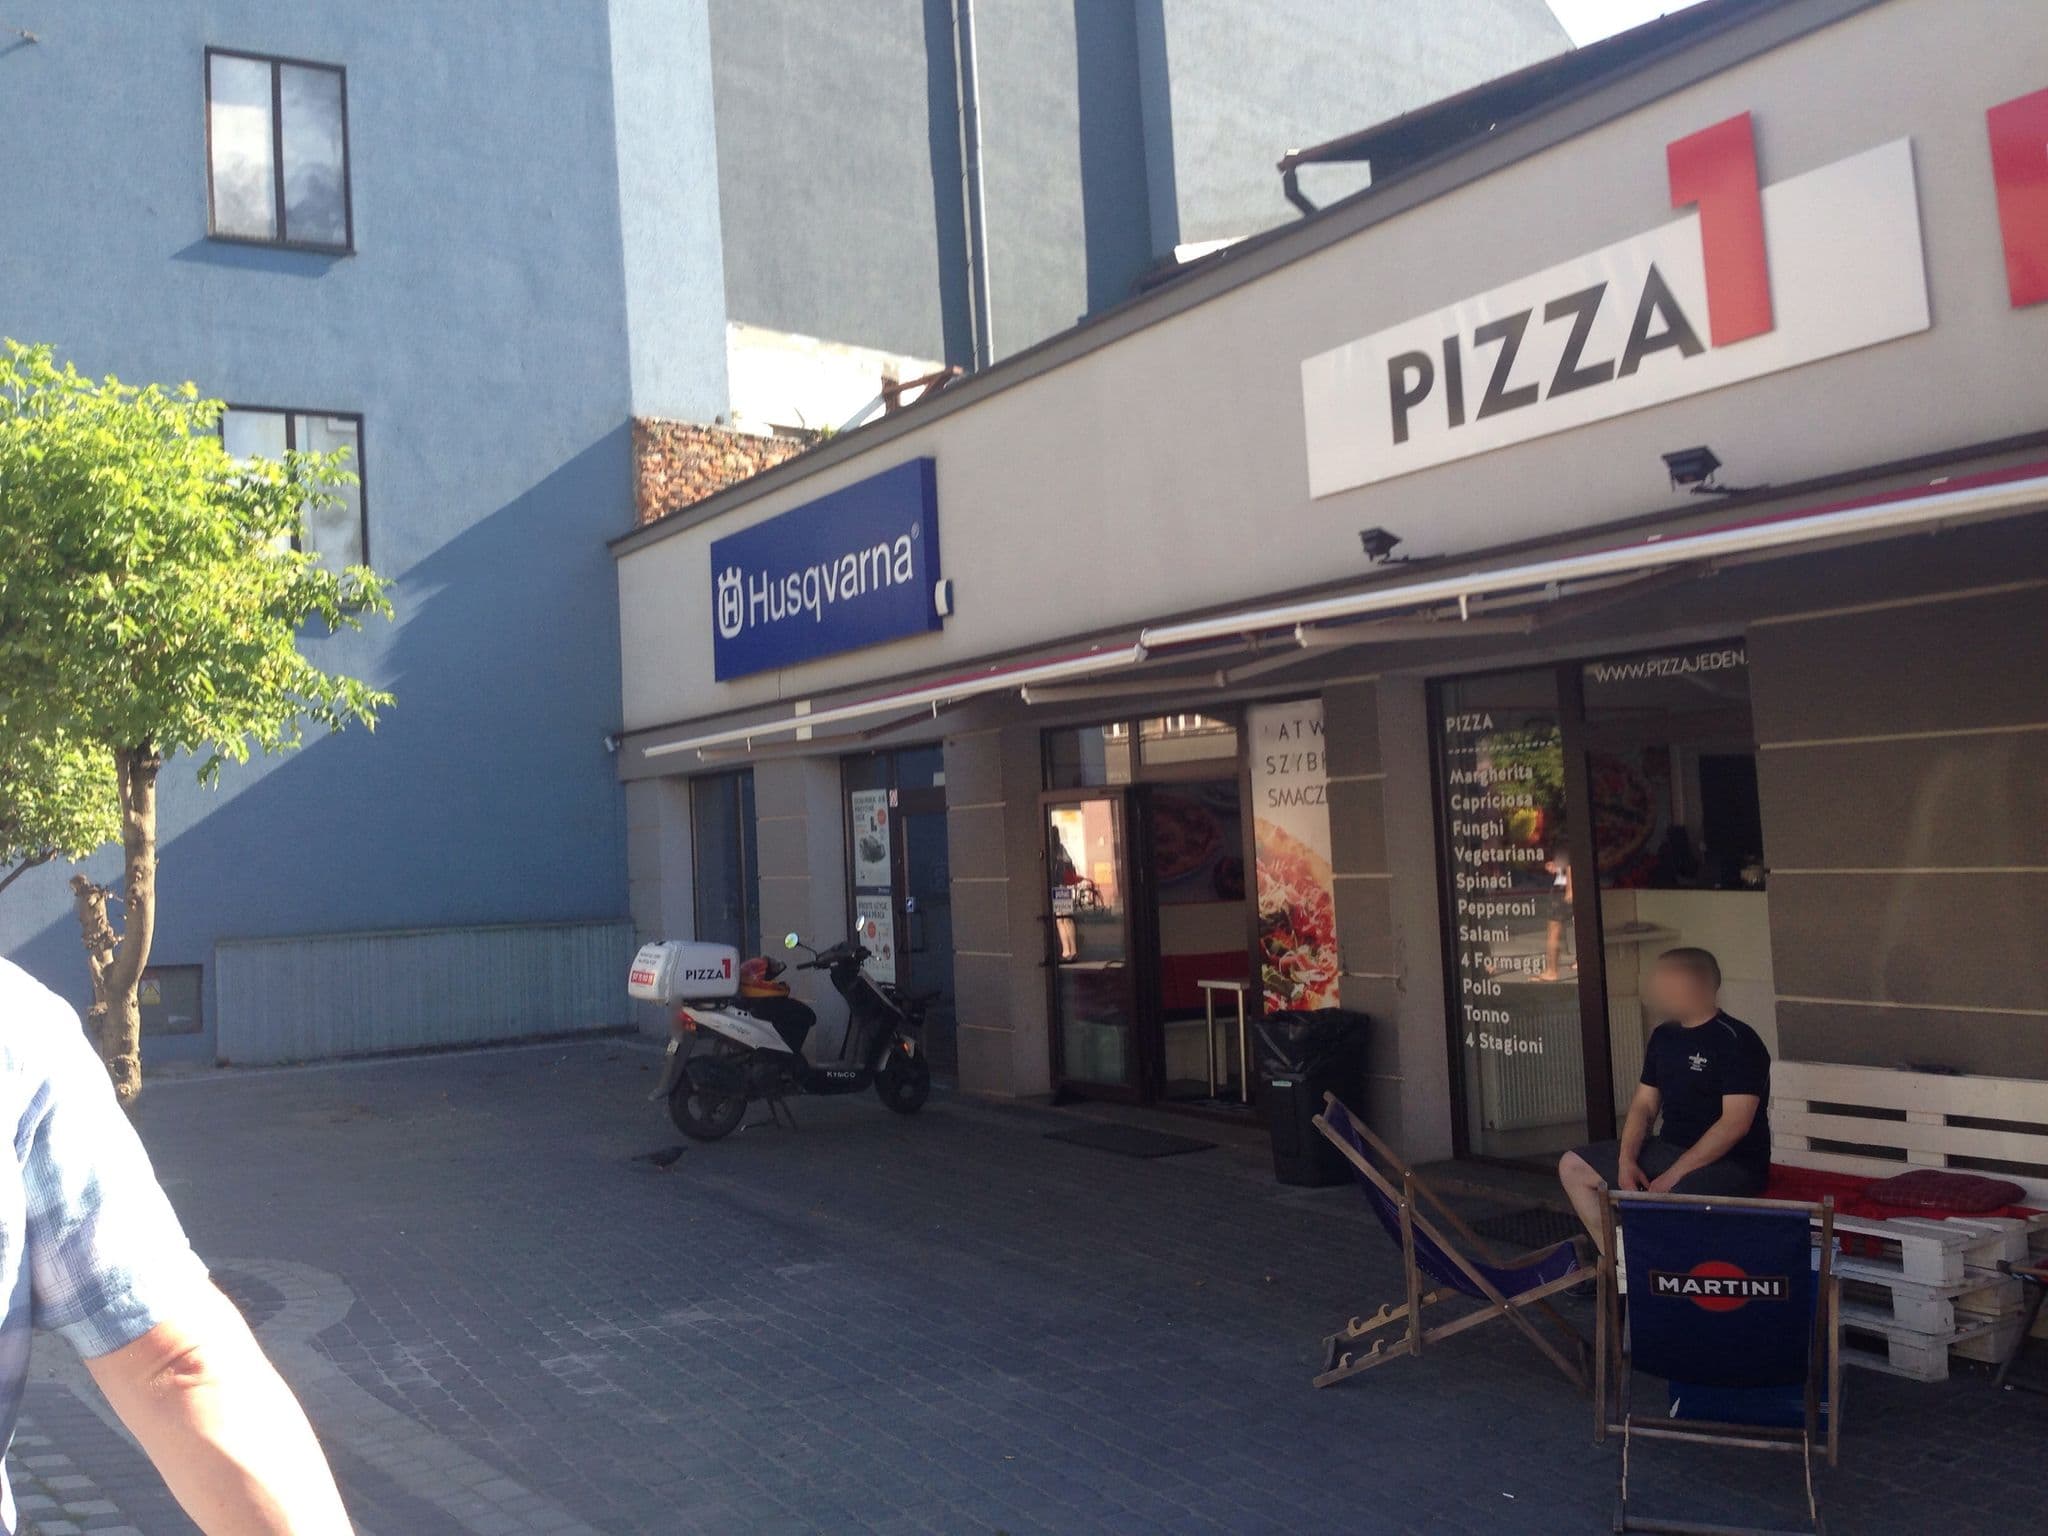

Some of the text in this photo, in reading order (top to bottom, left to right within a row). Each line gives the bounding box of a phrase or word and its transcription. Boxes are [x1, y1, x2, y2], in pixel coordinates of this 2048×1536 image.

[1446, 713, 1493, 733] PIZZA
[1450, 763, 1533, 787] Margherita
[1451, 791, 1533, 814] Capriciosa
[1453, 818, 1504, 840] Funghi
[1454, 843, 1545, 866] Vegetariana
[1456, 871, 1512, 892] Spinaci
[1458, 898, 1536, 919] Pepperoni
[1460, 925, 1509, 942] Salami
[1461, 952, 1546, 974] 4 Formaggi
[1463, 978, 1501, 996] Pollo
[1464, 1004, 1510, 1024] Tonno
[1466, 1032, 1544, 1056] 4 Stagioni
[826, 1071, 856, 1079] KYMCO
[1658, 1276, 1780, 1296] MARTINI
